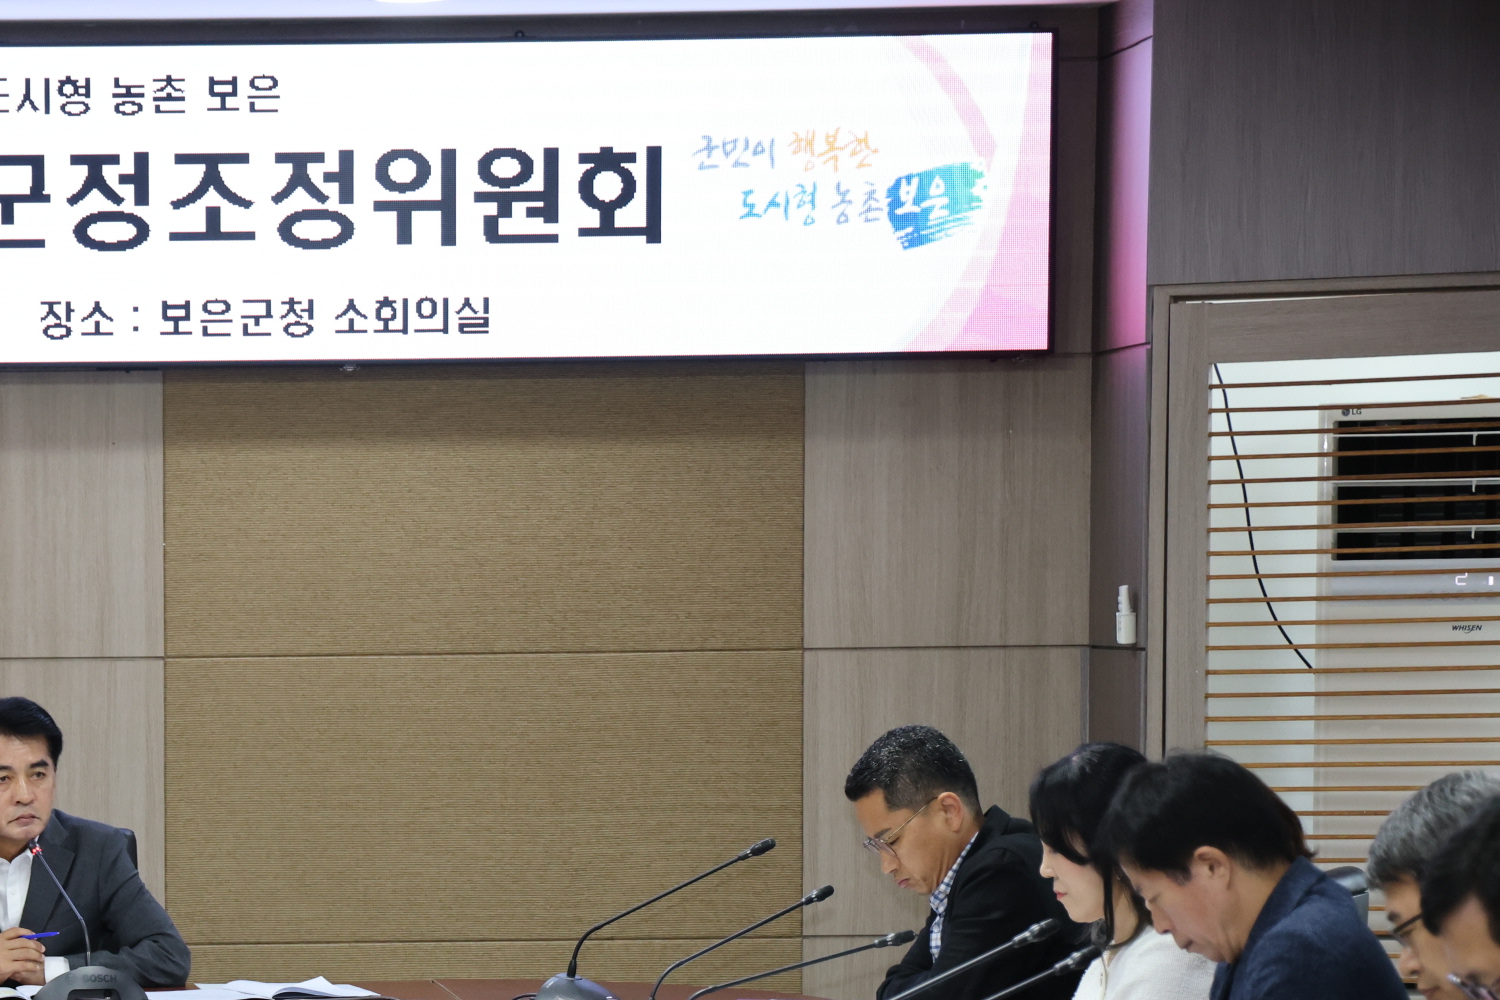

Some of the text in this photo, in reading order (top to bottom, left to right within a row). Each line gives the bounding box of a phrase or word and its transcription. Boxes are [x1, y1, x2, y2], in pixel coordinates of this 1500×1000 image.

[111, 74, 186, 116] 농촌
[206, 73, 281, 113] 보은
[692, 126, 880, 173] 군민이 행복한
[738, 175, 950, 227] 도시형 농촌 보은
[40, 300, 114, 341] 장소
[159, 297, 314, 338] 보은군청
[334, 296, 490, 335] 소회의실
[1452, 625, 1482, 633] WHISEN
[82, 974, 117, 983] BOSCH
